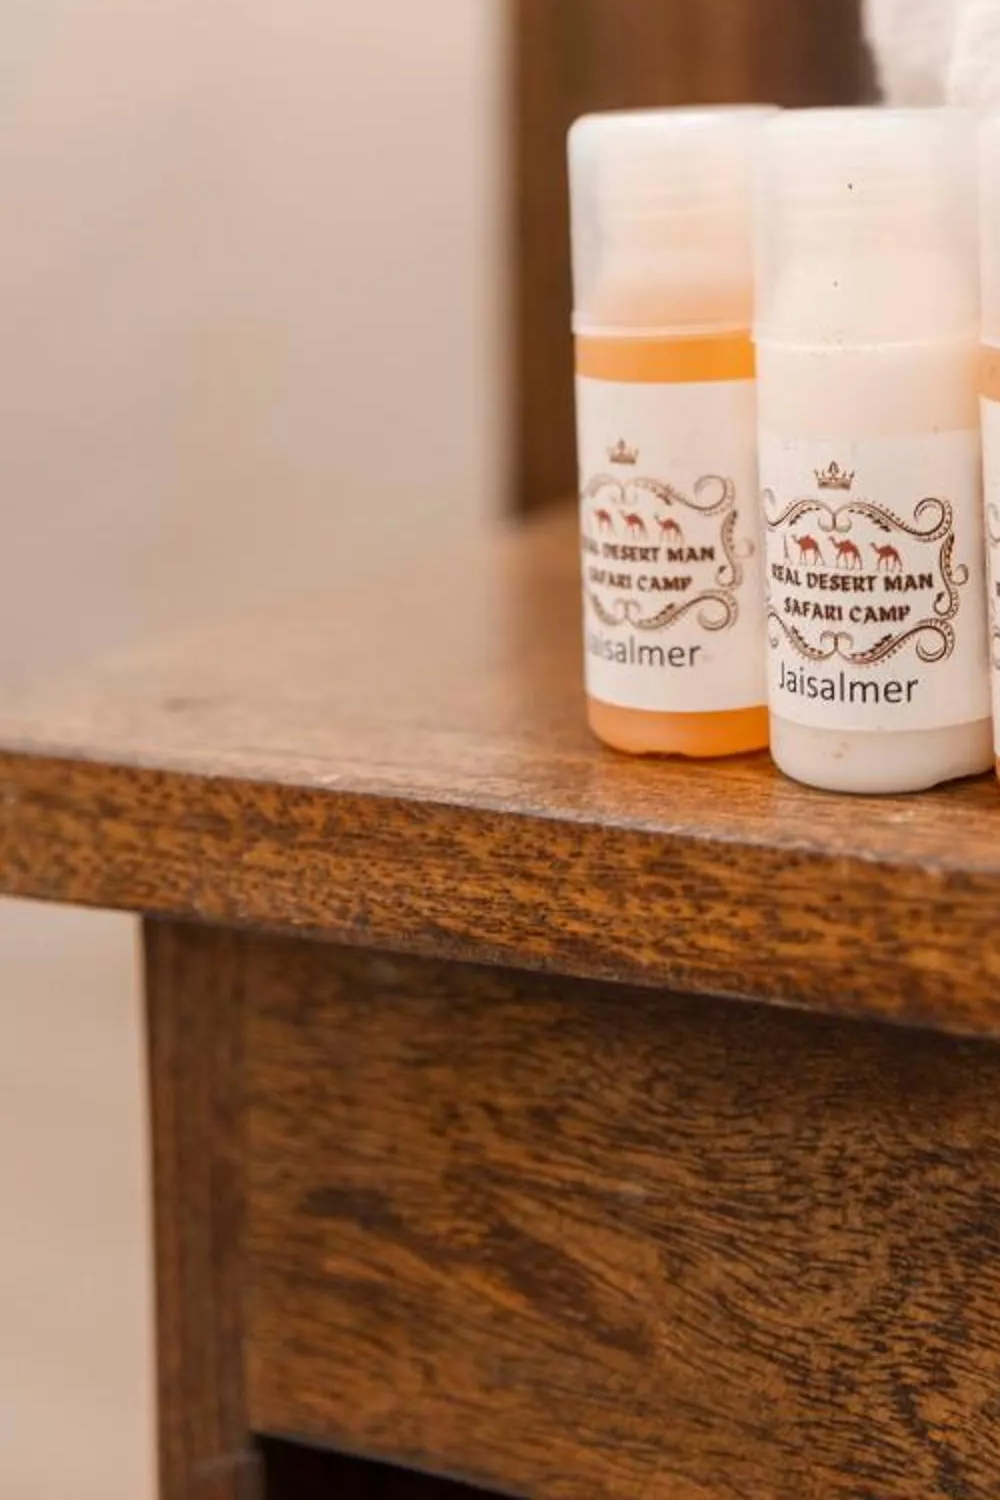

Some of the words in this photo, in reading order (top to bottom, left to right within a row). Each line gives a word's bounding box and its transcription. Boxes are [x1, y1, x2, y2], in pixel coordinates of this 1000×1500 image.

[603, 542, 660, 562] DESERT
[667, 546, 716, 563] MAN
[637, 575, 693, 592] CAMP
[773, 563, 801, 587] REAL
[806, 571, 876, 592] DESERT
[883, 573, 933, 592] MAN
[784, 596, 843, 621] SAFARI
[849, 604, 911, 623] CAMP
[779, 660, 919, 704] Jaisalmer
